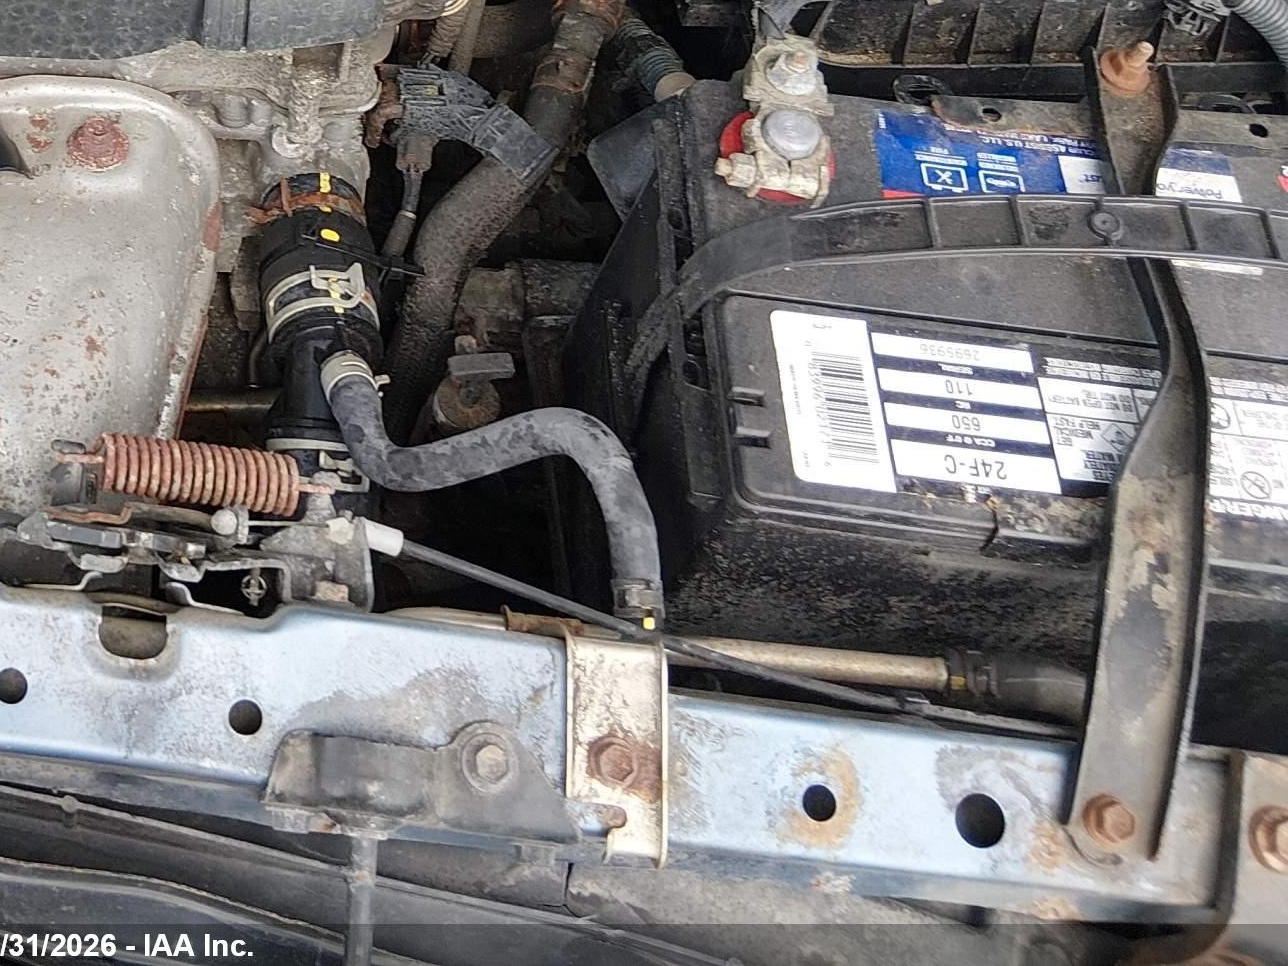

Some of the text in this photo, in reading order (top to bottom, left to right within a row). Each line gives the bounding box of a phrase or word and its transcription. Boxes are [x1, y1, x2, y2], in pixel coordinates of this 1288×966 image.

[945, 380, 973, 396] 110
[952, 415, 980, 431] 650
[944, 454, 1008, 480] 24F-C
